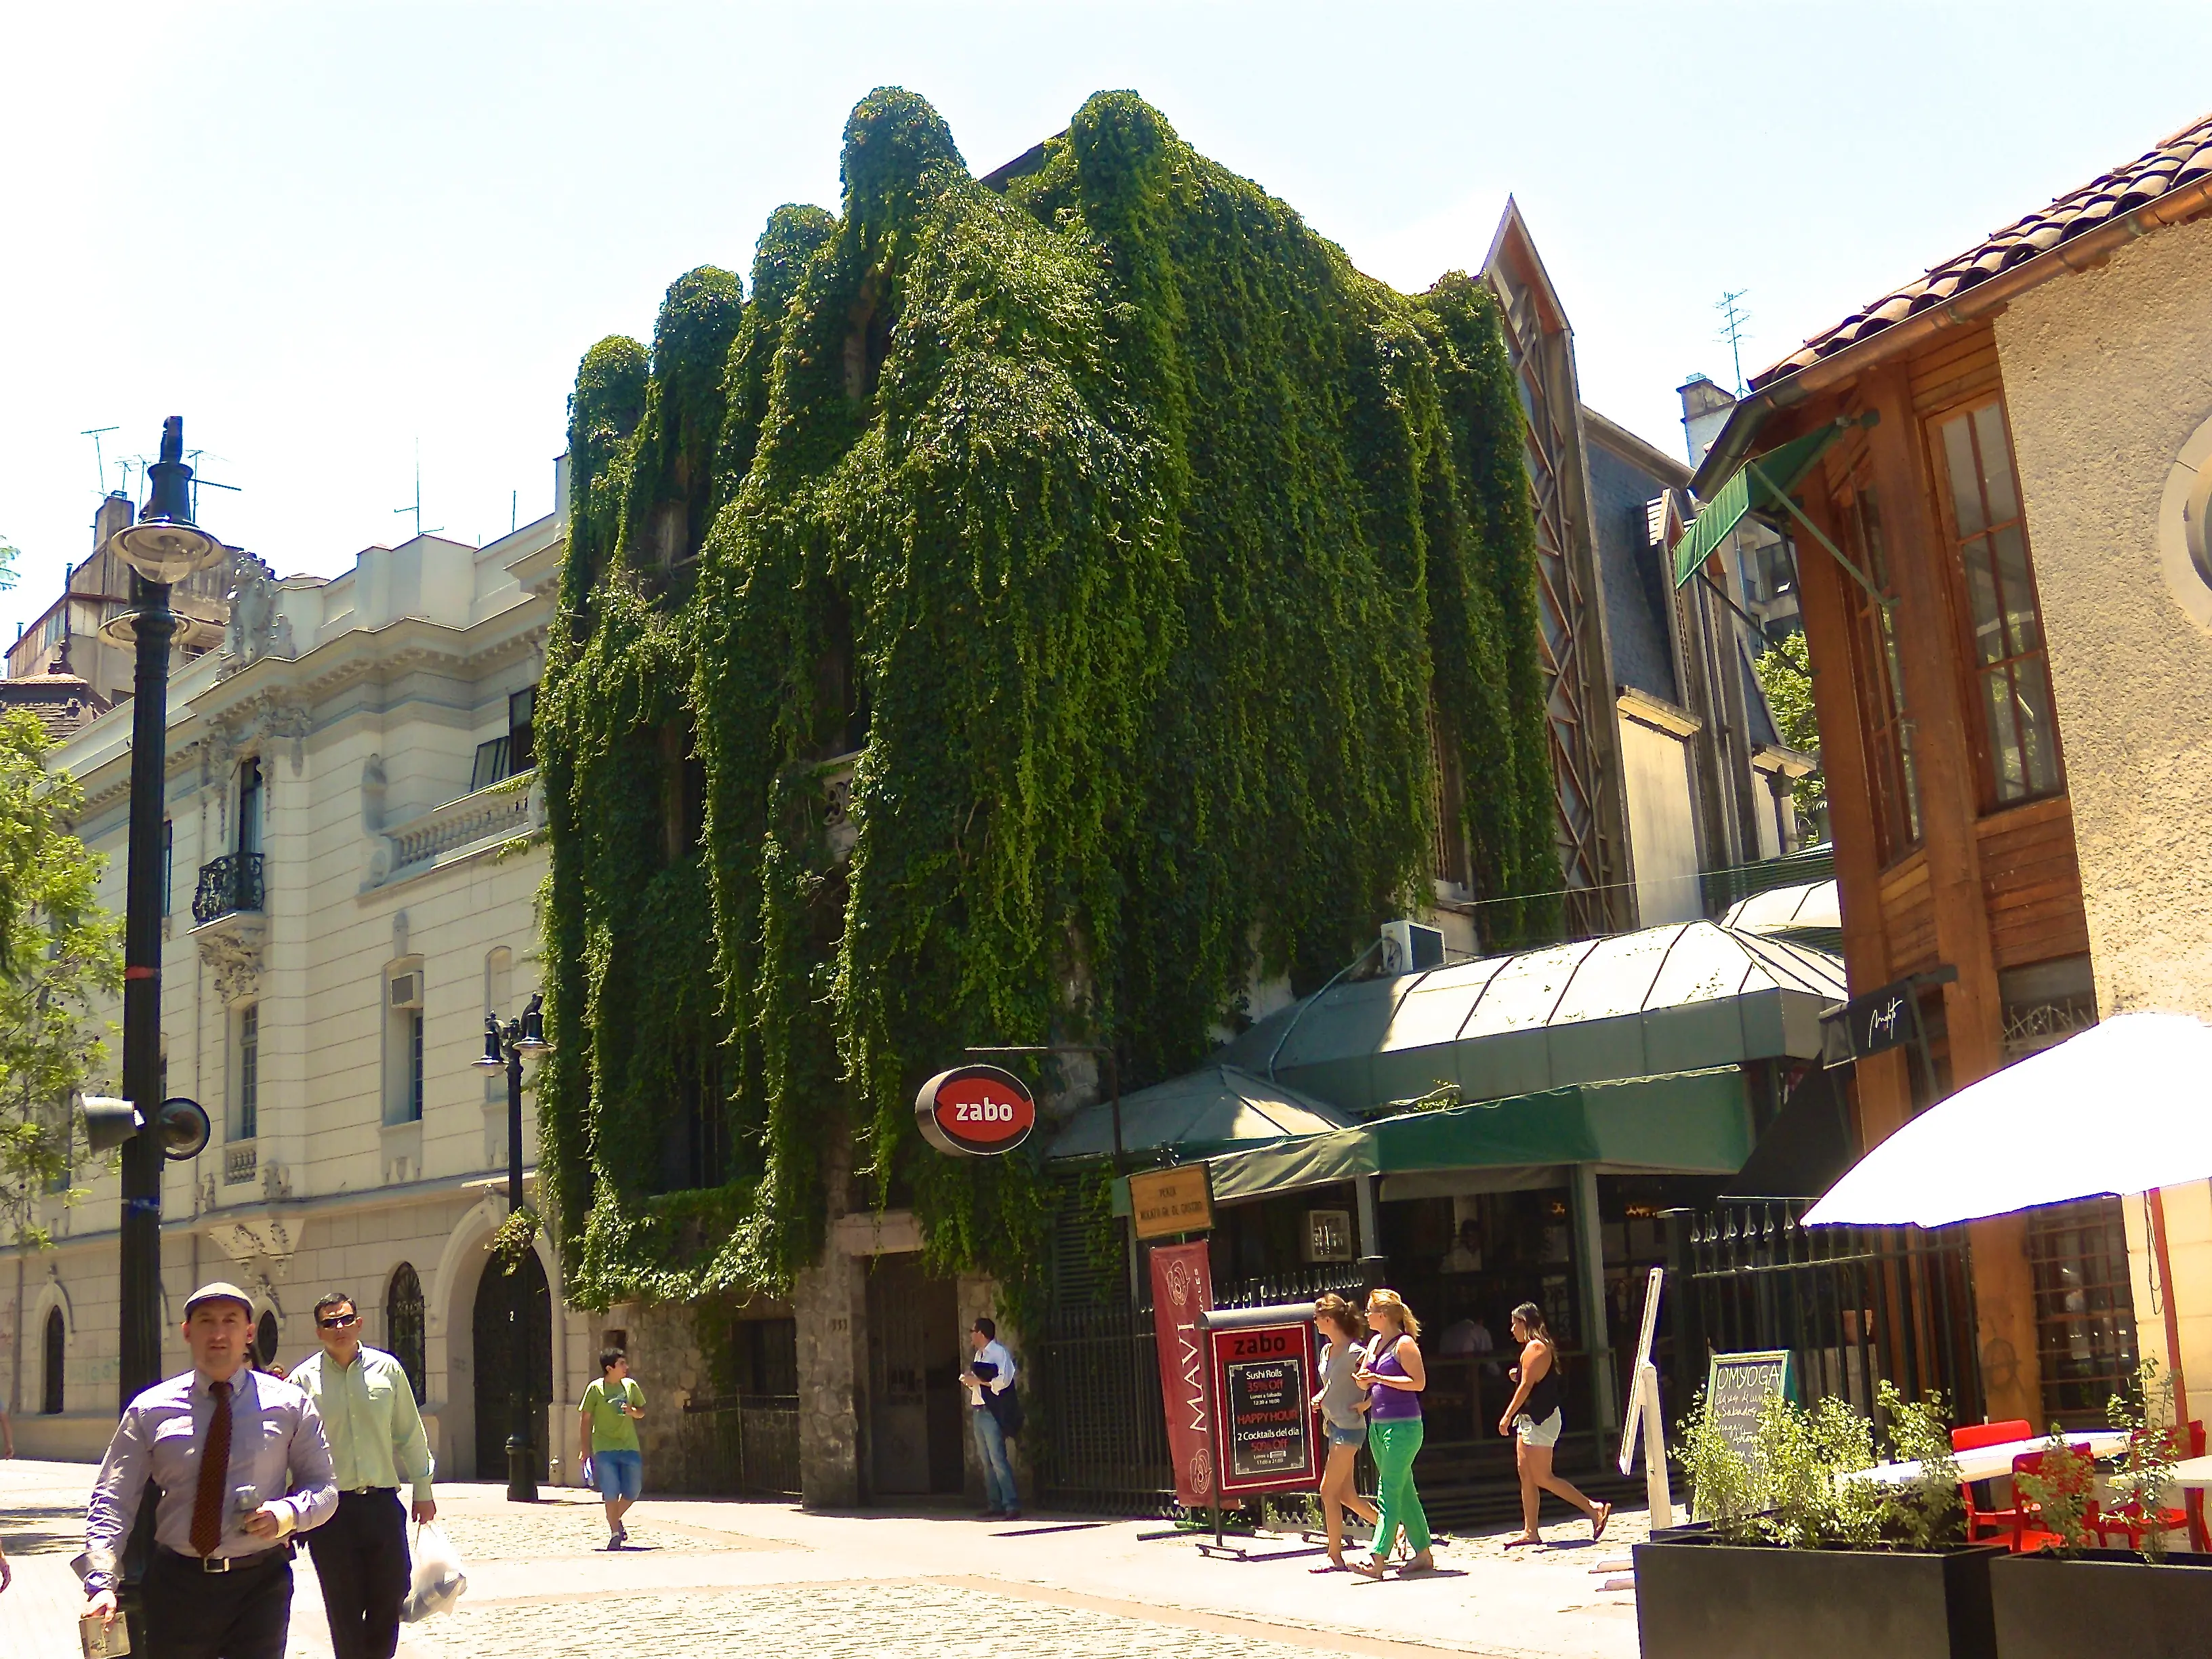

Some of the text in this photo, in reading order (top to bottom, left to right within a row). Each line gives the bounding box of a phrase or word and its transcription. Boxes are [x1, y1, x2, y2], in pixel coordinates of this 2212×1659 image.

[956, 1097, 1013, 1122] zabo
[510, 1311, 514, 1322] 2
[1234, 1332, 1286, 1355] zabo
[1177, 1320, 1208, 1433] MAVI
[1246, 1369, 1282, 1380] Sushi Rolls
[1269, 1379, 1284, 1391] Off
[1237, 1410, 1298, 1425] HAPPY HOUR
[1237, 1427, 1300, 1441] 2 Cocktails del día
[1250, 1438, 1288, 1452] 50% Off
